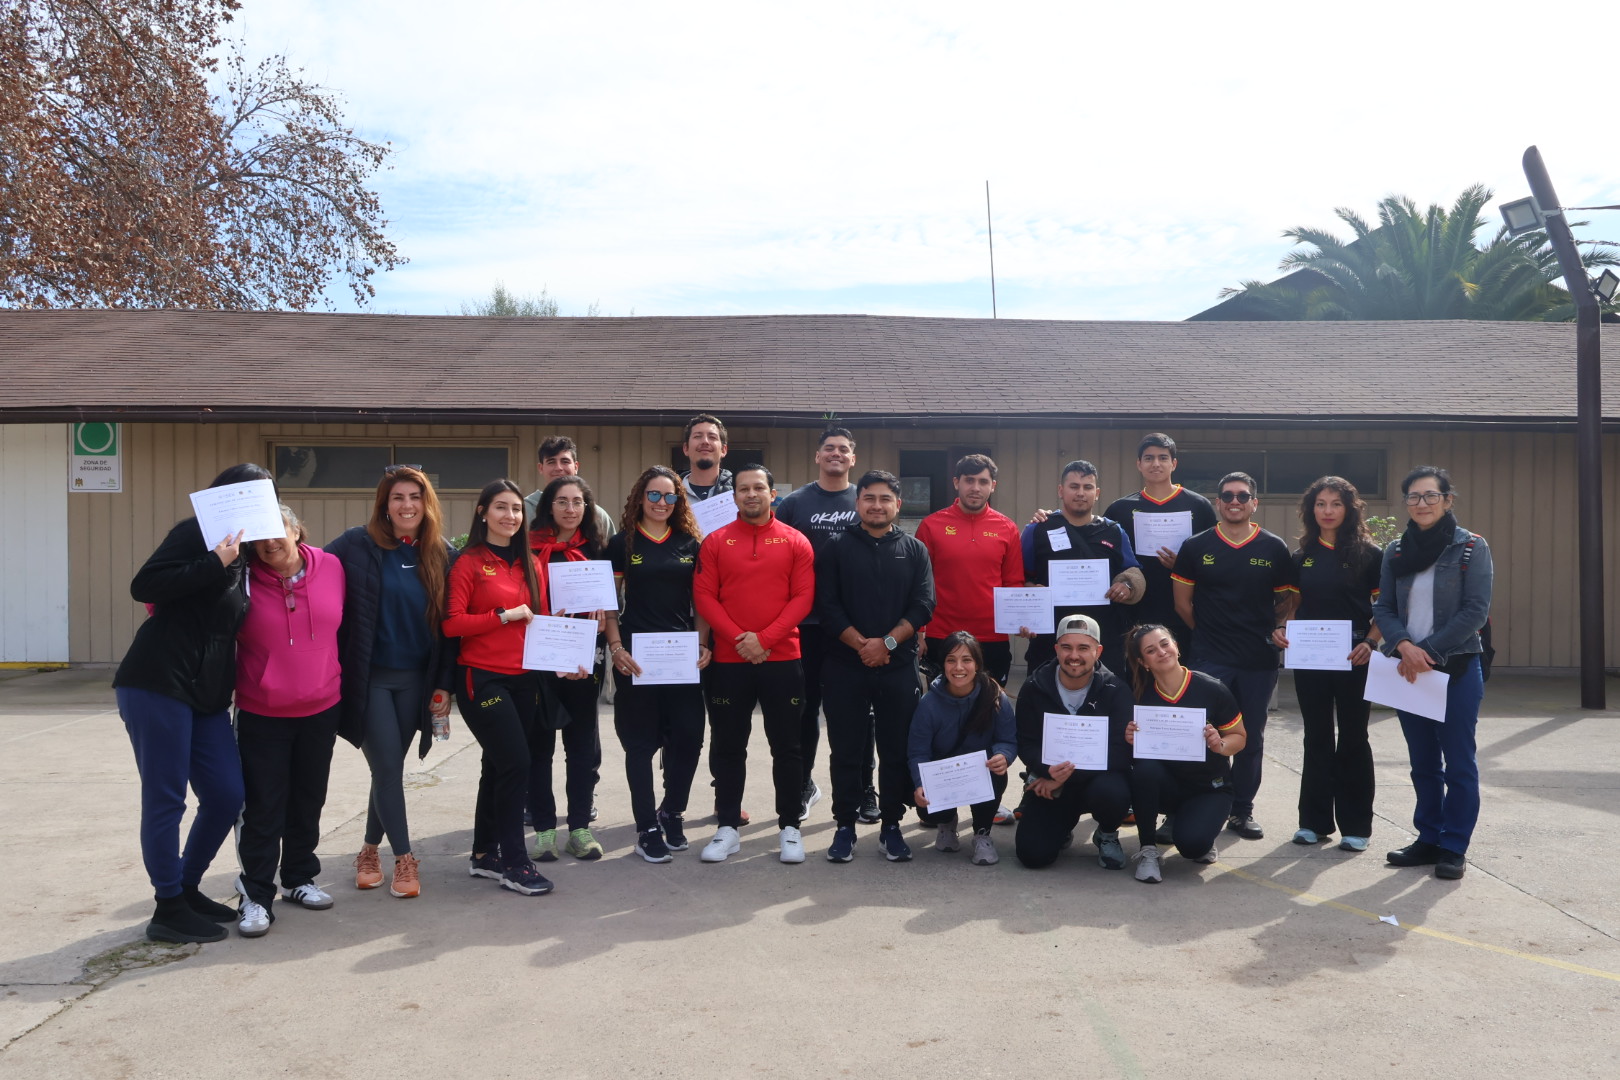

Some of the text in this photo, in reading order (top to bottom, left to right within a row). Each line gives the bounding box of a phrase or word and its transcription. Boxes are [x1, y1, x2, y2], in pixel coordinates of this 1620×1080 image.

[810, 511, 856, 524] OKAMI
[764, 537, 788, 545] SEK
[1249, 557, 1272, 568] SEK
[480, 695, 503, 708] SEK
[711, 696, 730, 705] SEK
